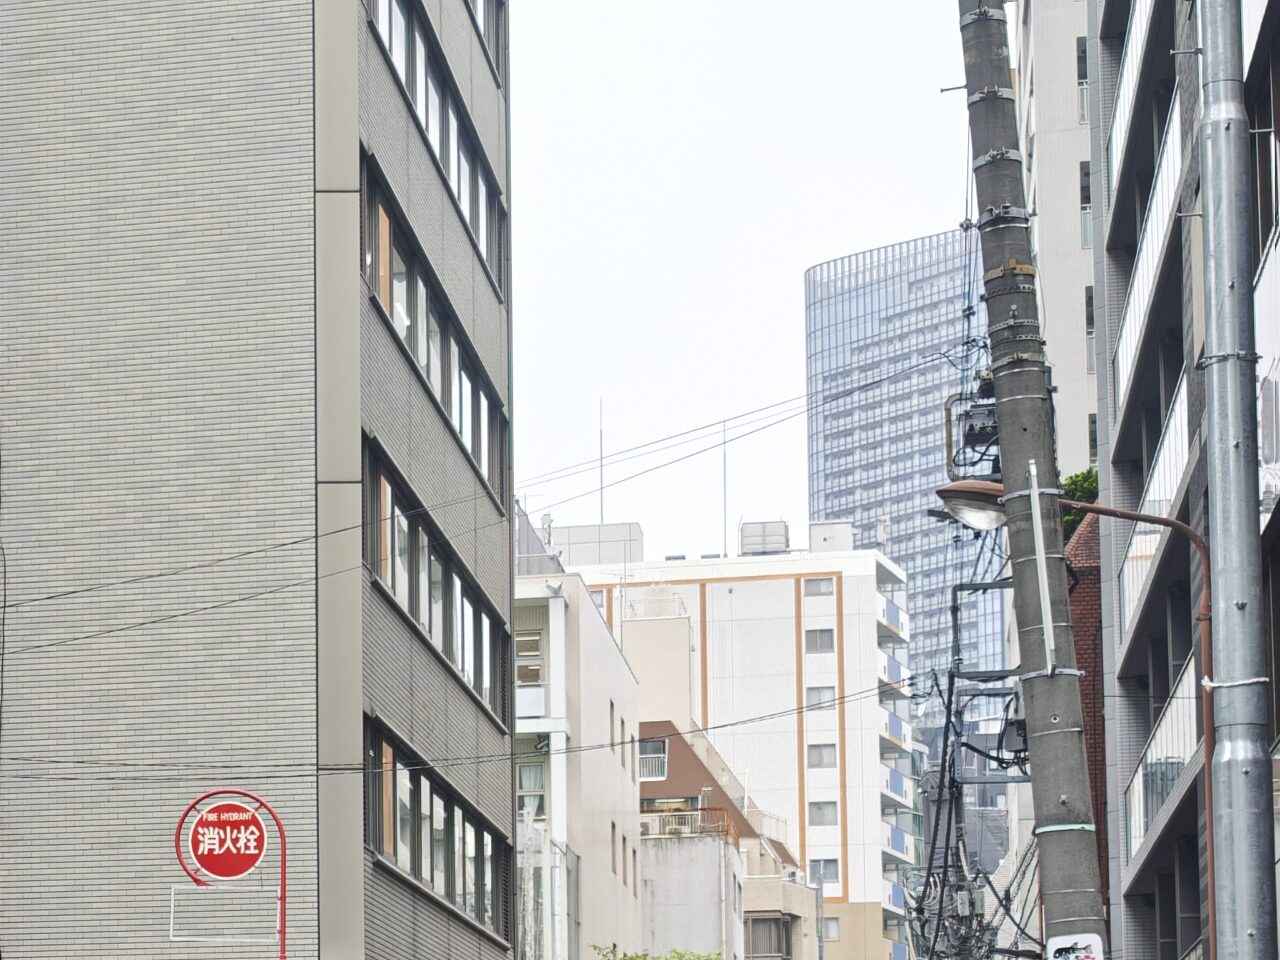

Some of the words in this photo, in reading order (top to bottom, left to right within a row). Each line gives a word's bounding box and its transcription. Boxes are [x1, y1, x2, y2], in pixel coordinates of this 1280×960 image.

[203, 812, 219, 822] FIRE
[220, 812, 253, 822] HYDRANT
[197, 825, 260, 856] 消火栓
